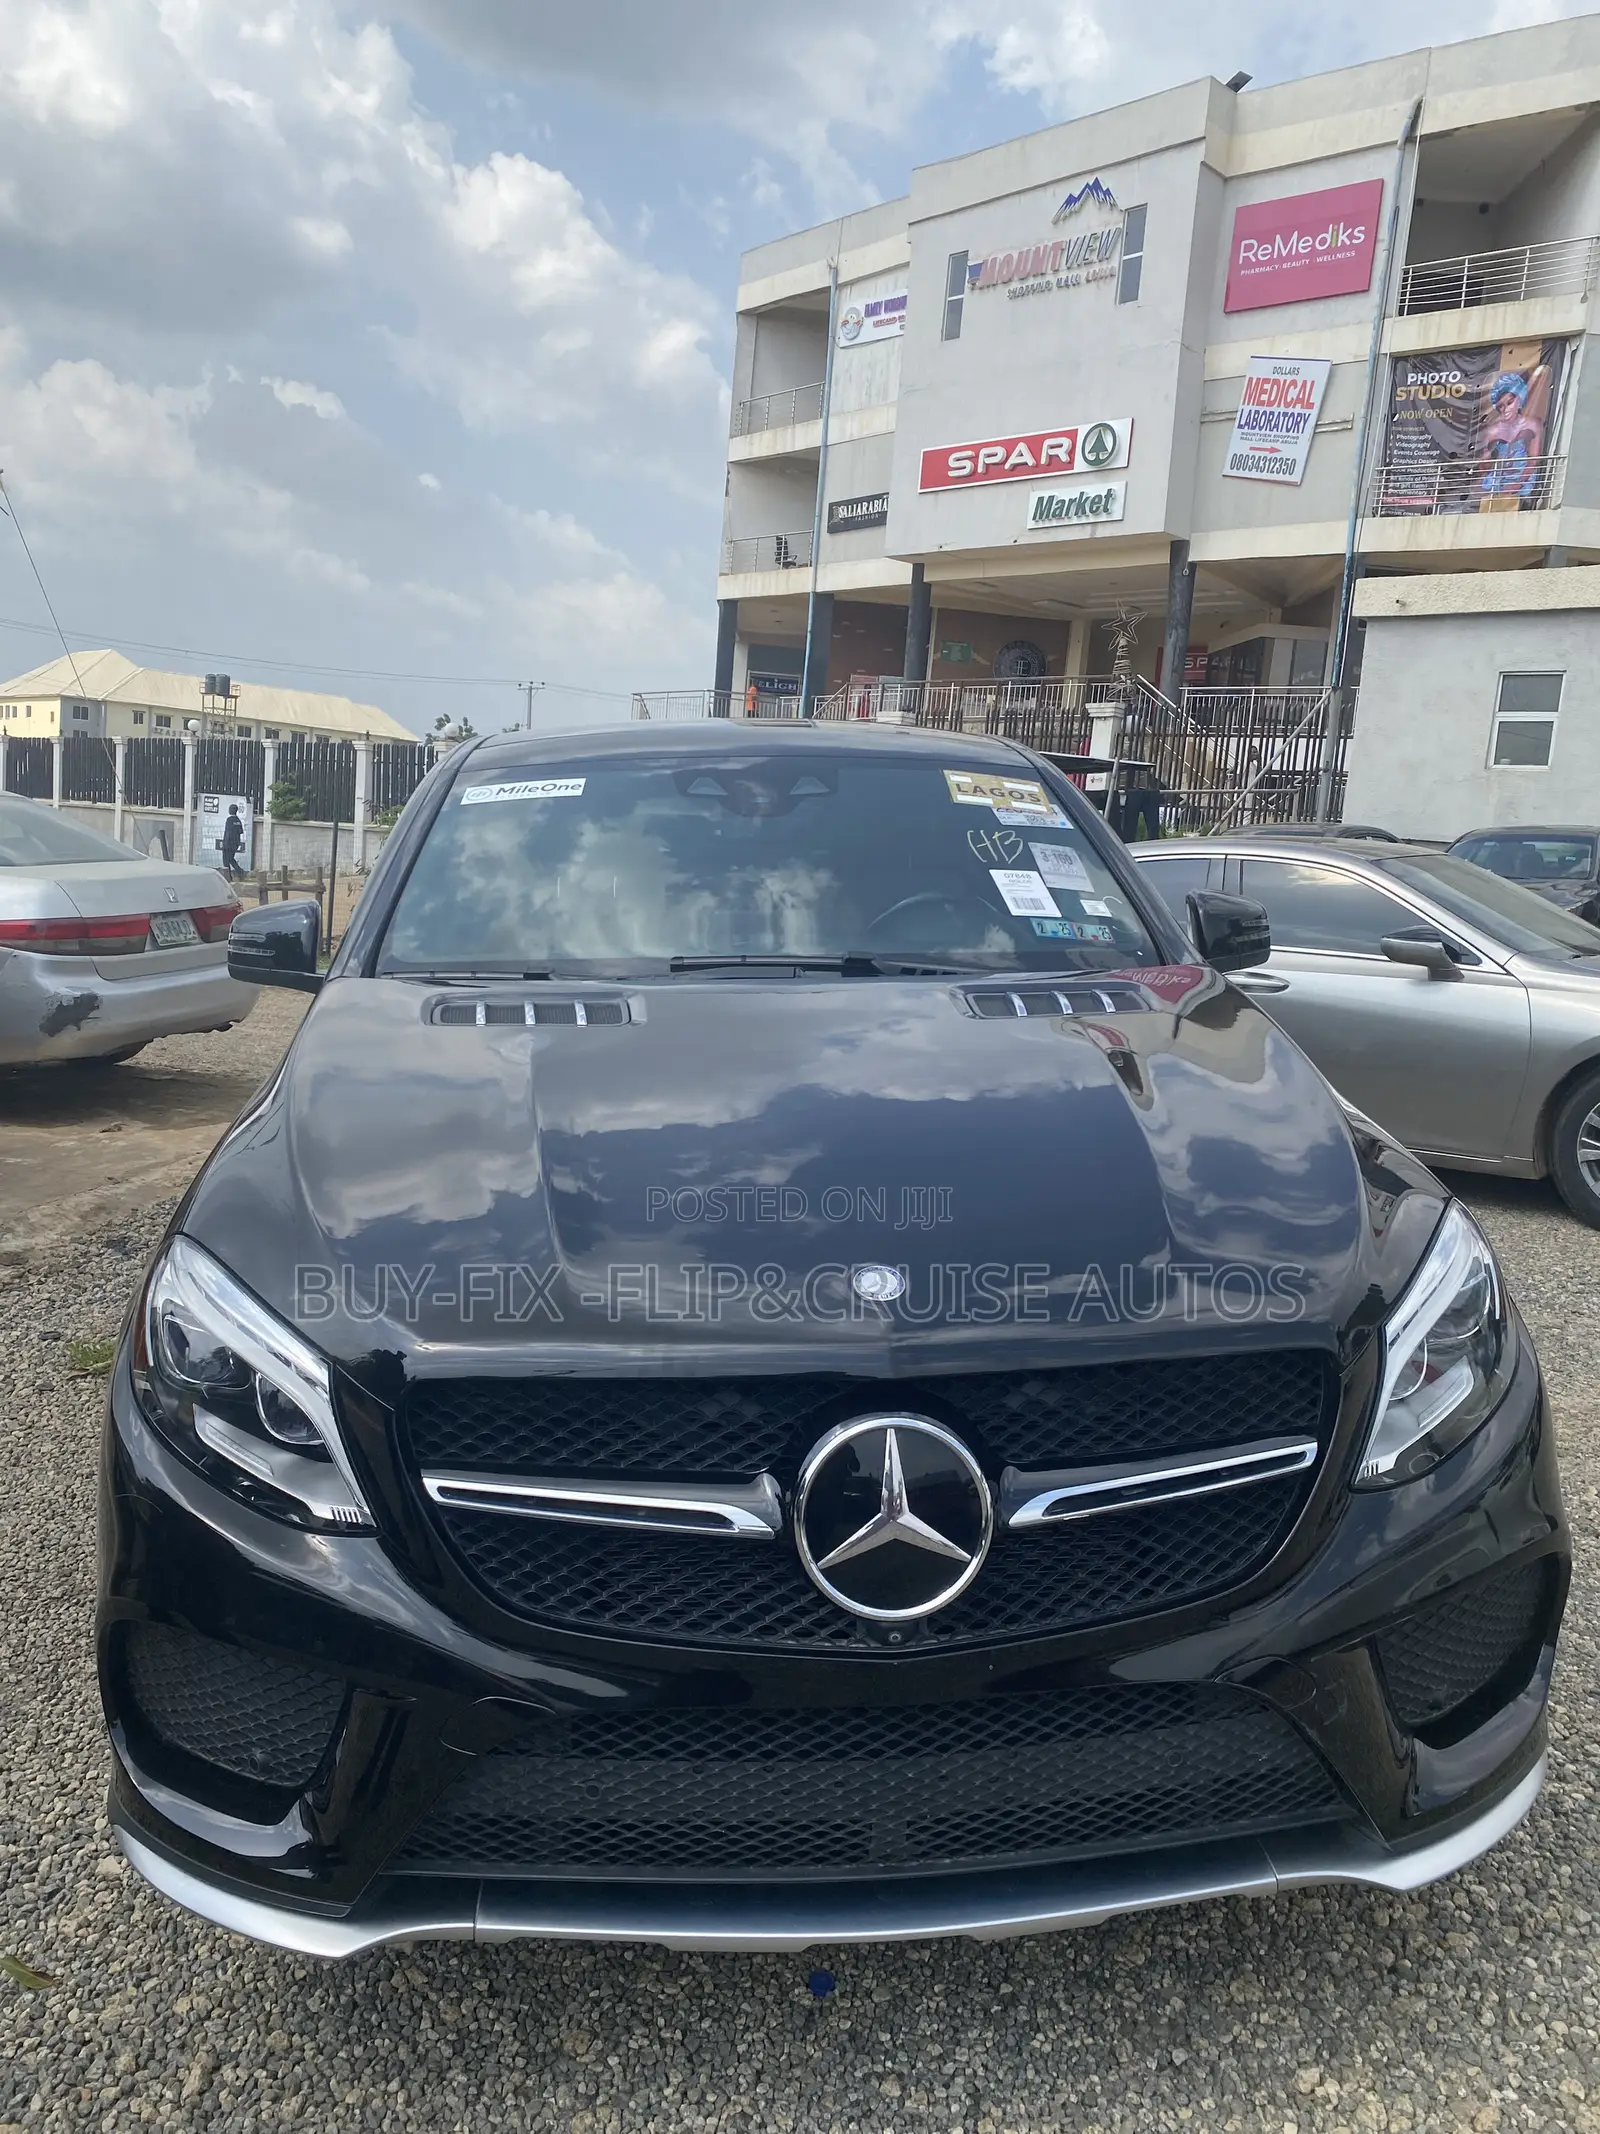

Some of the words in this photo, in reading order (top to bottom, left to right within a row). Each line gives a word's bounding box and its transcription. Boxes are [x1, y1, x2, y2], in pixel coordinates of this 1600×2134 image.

[1239, 222, 1366, 265] ReMediks
[976, 227, 1122, 291] MOUNTVIEW
[1316, 250, 1356, 262] WELLNESS
[1272, 366, 1300, 376] DOLLARS
[1407, 370, 1461, 385] PHOTO
[1242, 377, 1316, 410] MEDICAL
[1395, 383, 1467, 401] STUDIO
[1237, 409, 1311, 434] LABORATORY
[1400, 408, 1424, 420] NOW
[1425, 407, 1453, 418] OPEN
[1396, 434, 1432, 442] Photography
[947, 437, 1073, 478] SPAR
[1230, 453, 1297, 476] 08034312350
[1032, 488, 1116, 522] Market
[495, 783, 582, 796] MileOne
[955, 783, 1041, 803] LAGOS
[1058, 922, 1072, 936] 25
[1098, 928, 1112, 940] 25
